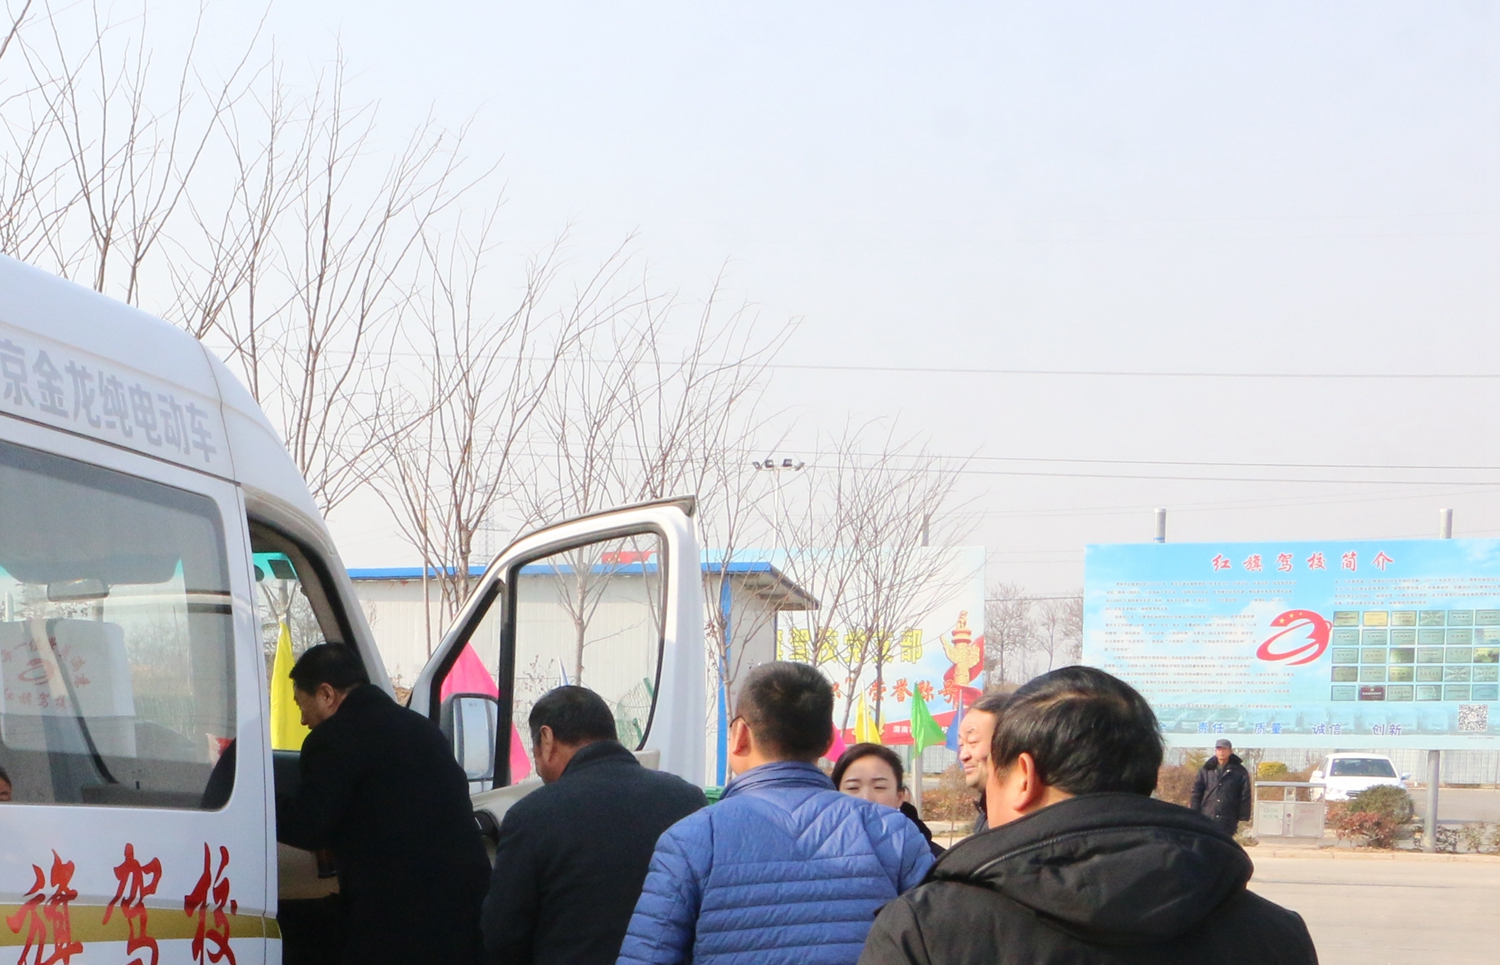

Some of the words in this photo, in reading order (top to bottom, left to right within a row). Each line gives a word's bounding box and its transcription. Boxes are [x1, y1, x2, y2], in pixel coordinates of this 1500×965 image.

[1211, 551, 1394, 573] 红旗驾校简介
